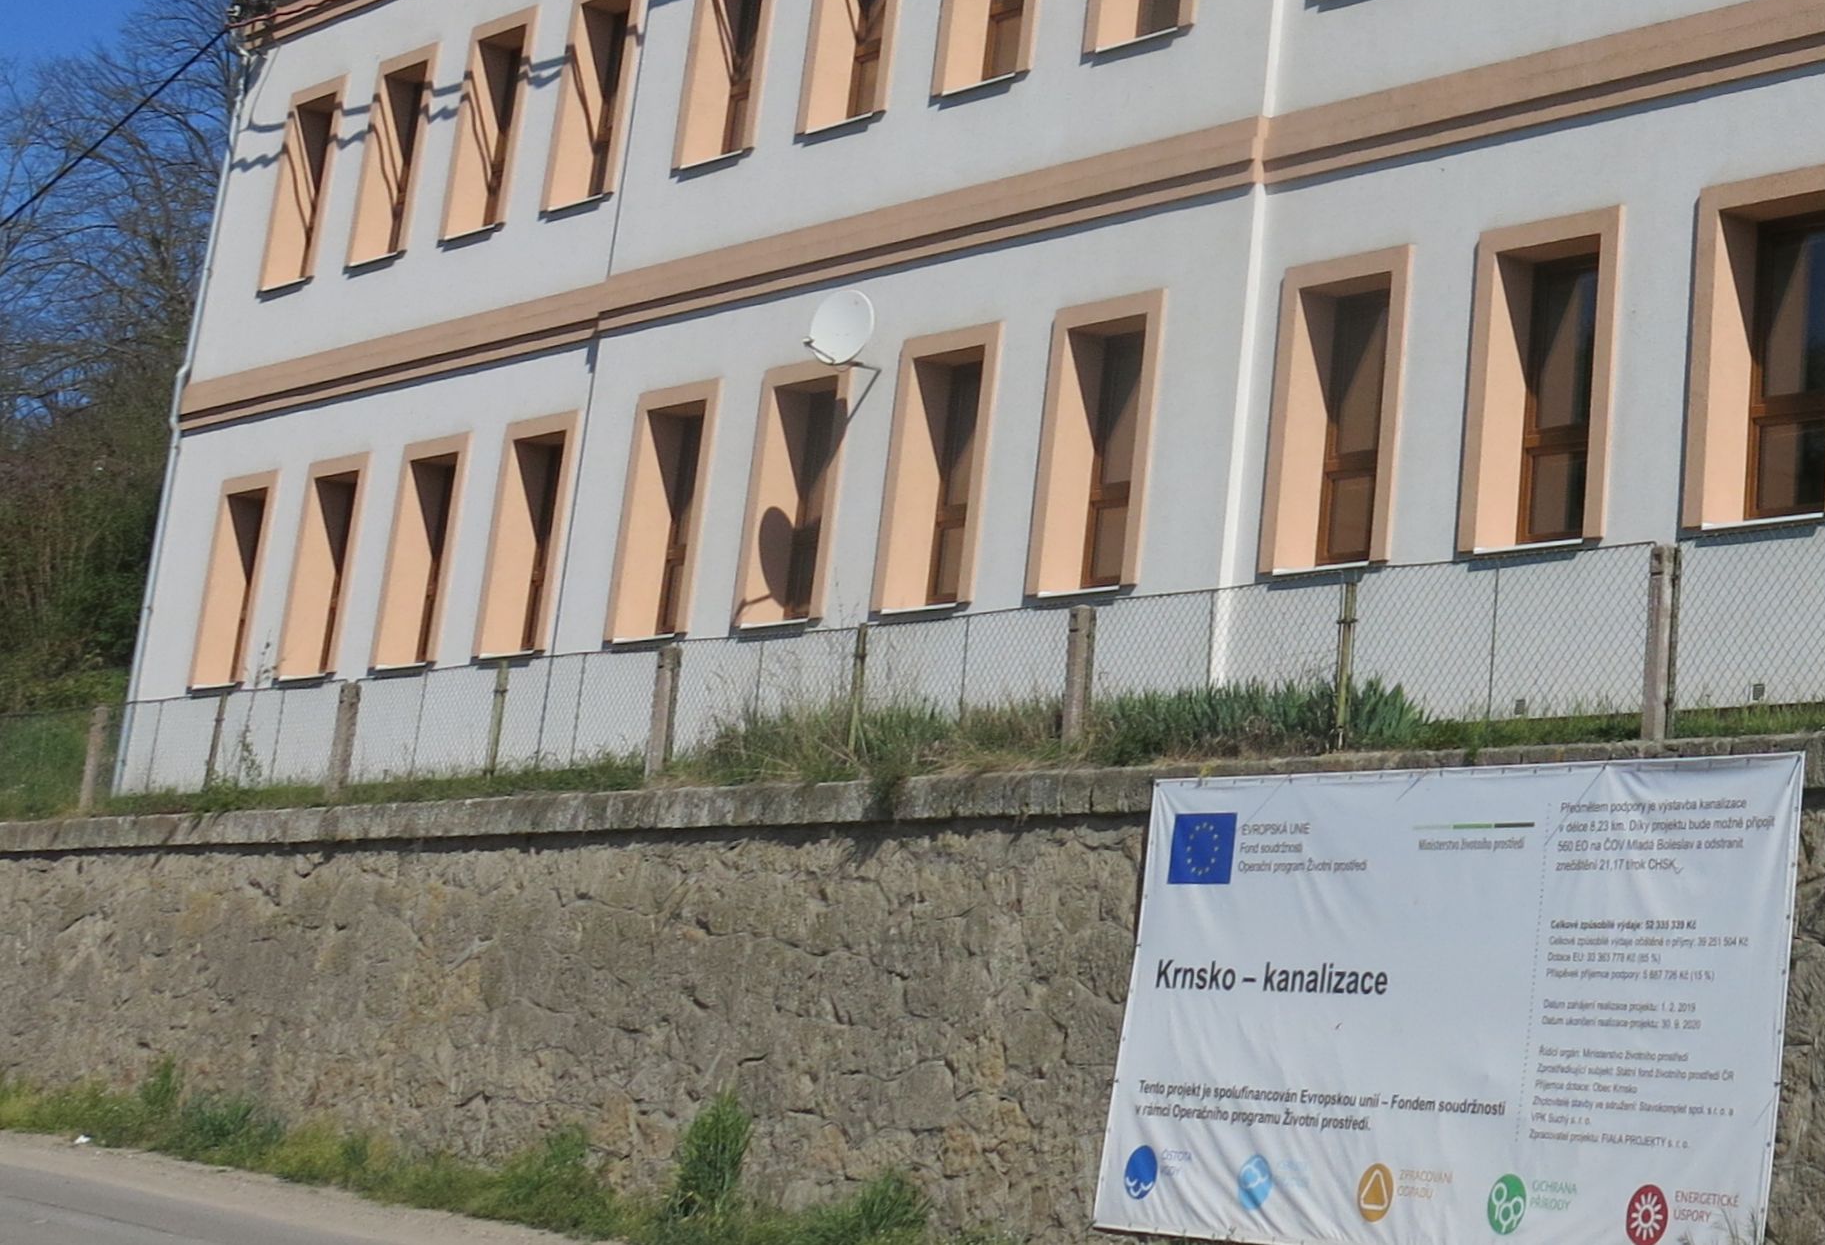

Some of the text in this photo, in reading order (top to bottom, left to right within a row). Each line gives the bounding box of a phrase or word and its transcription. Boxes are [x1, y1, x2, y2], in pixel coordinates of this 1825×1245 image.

[1610, 801, 1646, 814] podpory
[1647, 802, 1656, 814] je
[1658, 799, 1697, 813] výstavba
[1699, 798, 1747, 810] kanalizace
[1241, 822, 1310, 835] EVROPSKÁ UNIE
[1629, 819, 1650, 834] Díky
[1651, 819, 1686, 833] projektu
[1688, 819, 1711, 830] bude
[1713, 817, 1743, 829] možné
[1745, 815, 1775, 830] připojit
[1240, 842, 1259, 853] Fond
[1575, 840, 1589, 852] EO
[1590, 842, 1601, 851] na
[1603, 837, 1626, 851] ČOV
[1656, 838, 1695, 851] Boleslav
[1696, 841, 1702, 849] a
[1704, 837, 1744, 849] odstranit
[1238, 858, 1368, 874] Operační program Životní prostředí
[1599, 858, 1625, 872] 21,17
[1155, 958, 1237, 991] Krnsko
[1262, 961, 1389, 995] kanalizace
[1139, 1079, 1165, 1095] Tento
[1166, 1083, 1201, 1098] projekt
[1201, 1083, 1212, 1101] je
[1213, 1085, 1297, 1104] spolufinancován
[1300, 1089, 1356, 1108] Evropskou
[1359, 1092, 1380, 1107] unií
[1390, 1094, 1436, 1112] Fondem
[1438, 1098, 1506, 1116] soudržnosti
[1135, 1104, 1371, 1132] v rámci Operačního programu Životní prostředí.
[1531, 1179, 1577, 1195] OCHRANA
[1675, 1190, 1739, 1208] ENERGETICKÉ
